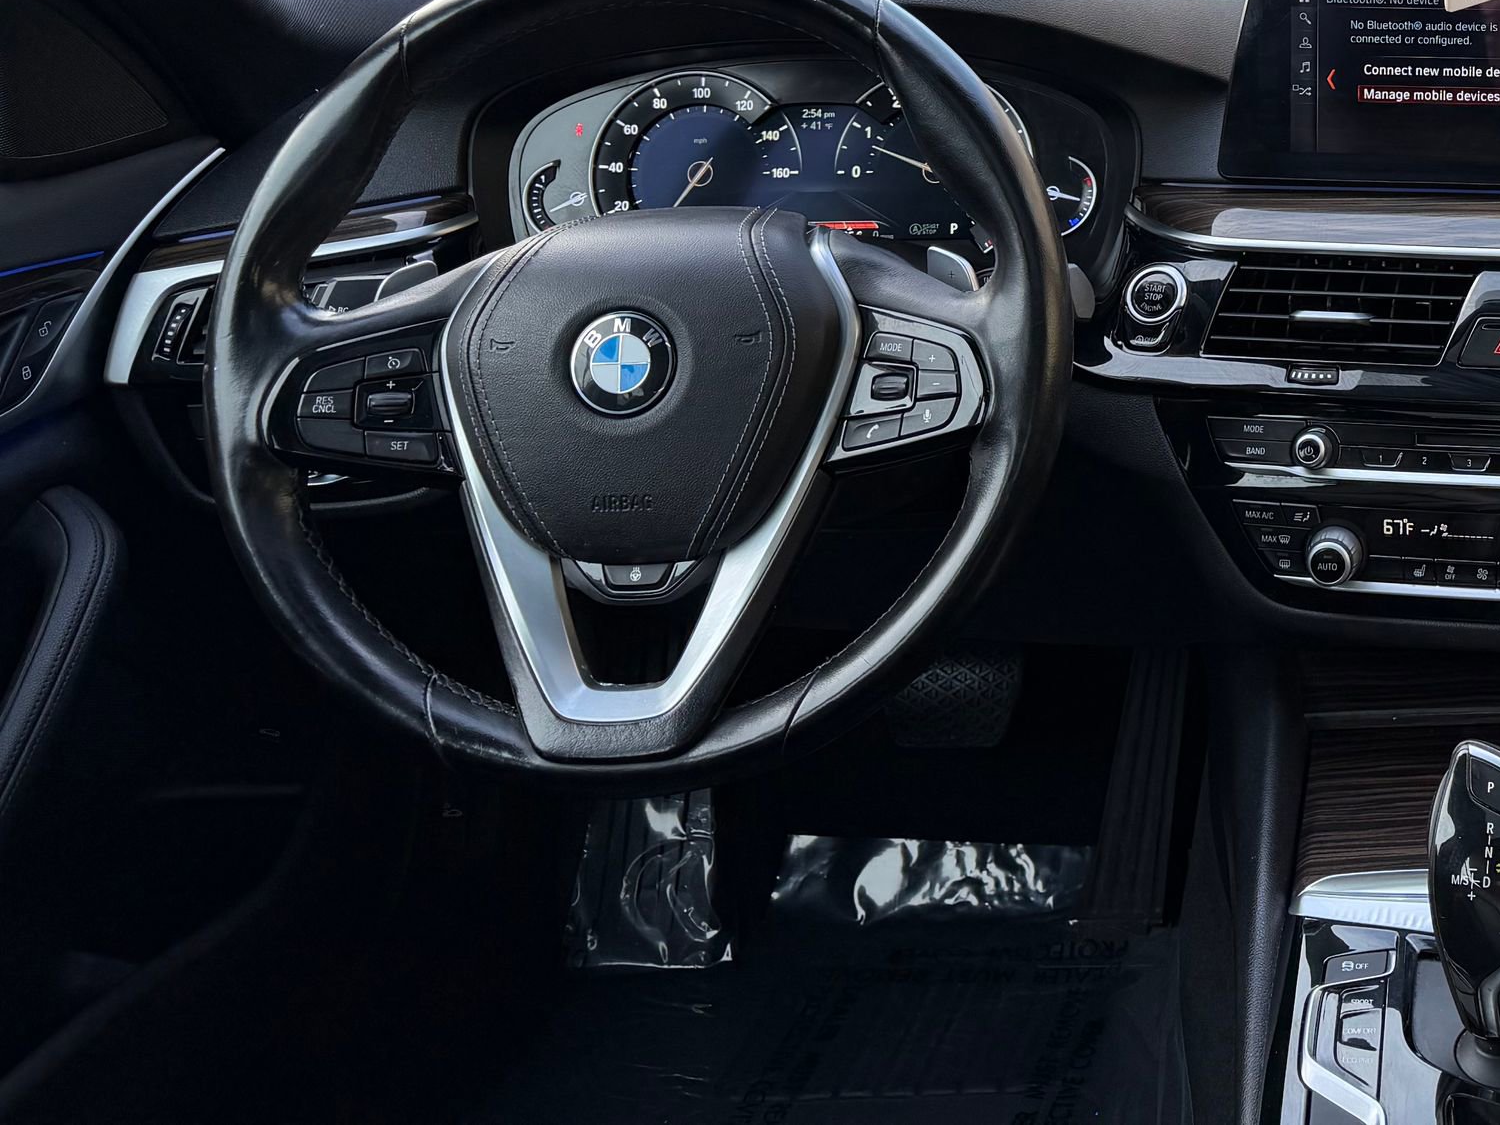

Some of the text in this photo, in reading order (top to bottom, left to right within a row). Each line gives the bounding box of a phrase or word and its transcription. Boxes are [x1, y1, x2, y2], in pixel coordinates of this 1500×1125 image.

[1350, 20, 1364, 30] No
[1426, 21, 1452, 31] audio
[1456, 21, 1486, 32] device
[1490, 22, 1498, 32] is
[1350, 34, 1472, 47] connected or configured.
[1364, 64, 1412, 76] Connect
[1416, 68, 1439, 77] new
[1443, 66, 1482, 77] mobile
[692, 87, 711, 99] 100
[1364, 89, 1500, 102] Manage mobile devices
[652, 98, 667, 109] 80
[735, 100, 754, 111] 120
[802, 109, 822, 119] 2:54
[623, 124, 638, 135] 60
[865, 126, 871, 139] 1
[761, 130, 780, 141] 140
[608, 162, 624, 173] 40
[771, 167, 790, 179] 160
[852, 166, 860, 178] 0
[614, 200, 629, 211] 20
[950, 223, 958, 234] P
[1144, 284, 1166, 293] START
[1144, 293, 1163, 301] STOP
[584, 318, 663, 348] BMW
[880, 342, 903, 352] MODE
[315, 396, 334, 405] RES
[312, 405, 336, 413] CNCL
[1243, 425, 1264, 433] MODE
[390, 441, 408, 450] SET
[1246, 447, 1265, 455] BAND
[1422, 456, 1428, 465] 2
[1467, 459, 1472, 467] 3
[592, 495, 653, 512] AIRBAG
[1245, 510, 1274, 519] MAX A/C
[1262, 535, 1277, 543] MAX
[1317, 563, 1338, 571] AUTO
[1487, 781, 1495, 793] P
[1486, 822, 1494, 834] R
[1484, 846, 1493, 859] N
[1482, 876, 1491, 888] D
